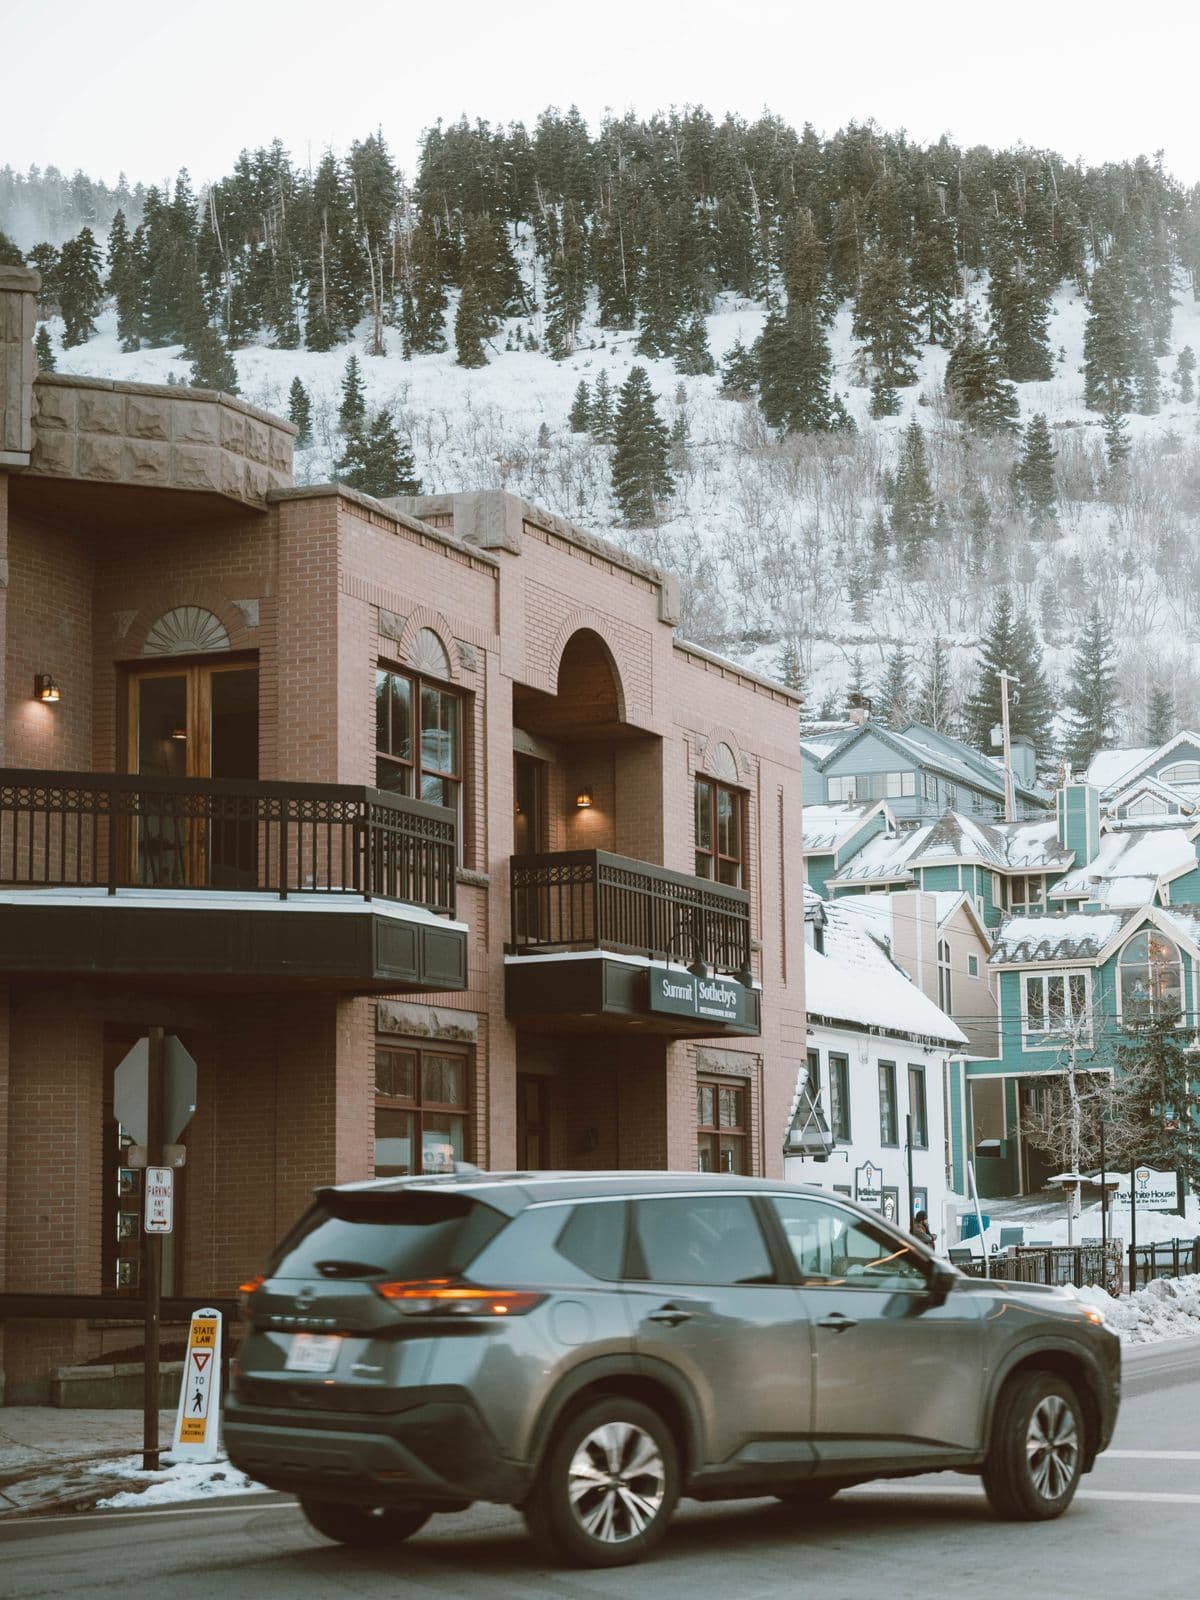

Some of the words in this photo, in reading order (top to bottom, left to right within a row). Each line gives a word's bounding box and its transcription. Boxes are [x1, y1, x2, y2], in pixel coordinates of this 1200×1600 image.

[663, 979, 693, 1001] Summit
[699, 982, 737, 1008] Sotheby's
[156, 1172, 164, 1184] NO
[148, 1185, 171, 1198] PARKING
[1151, 1190, 1176, 1198] House
[154, 1199, 164, 1207] ANY
[153, 1208, 165, 1217] TIME
[193, 1326, 215, 1335] STATE
[196, 1335, 211, 1344] LAW
[195, 1376, 205, 1385] TO
